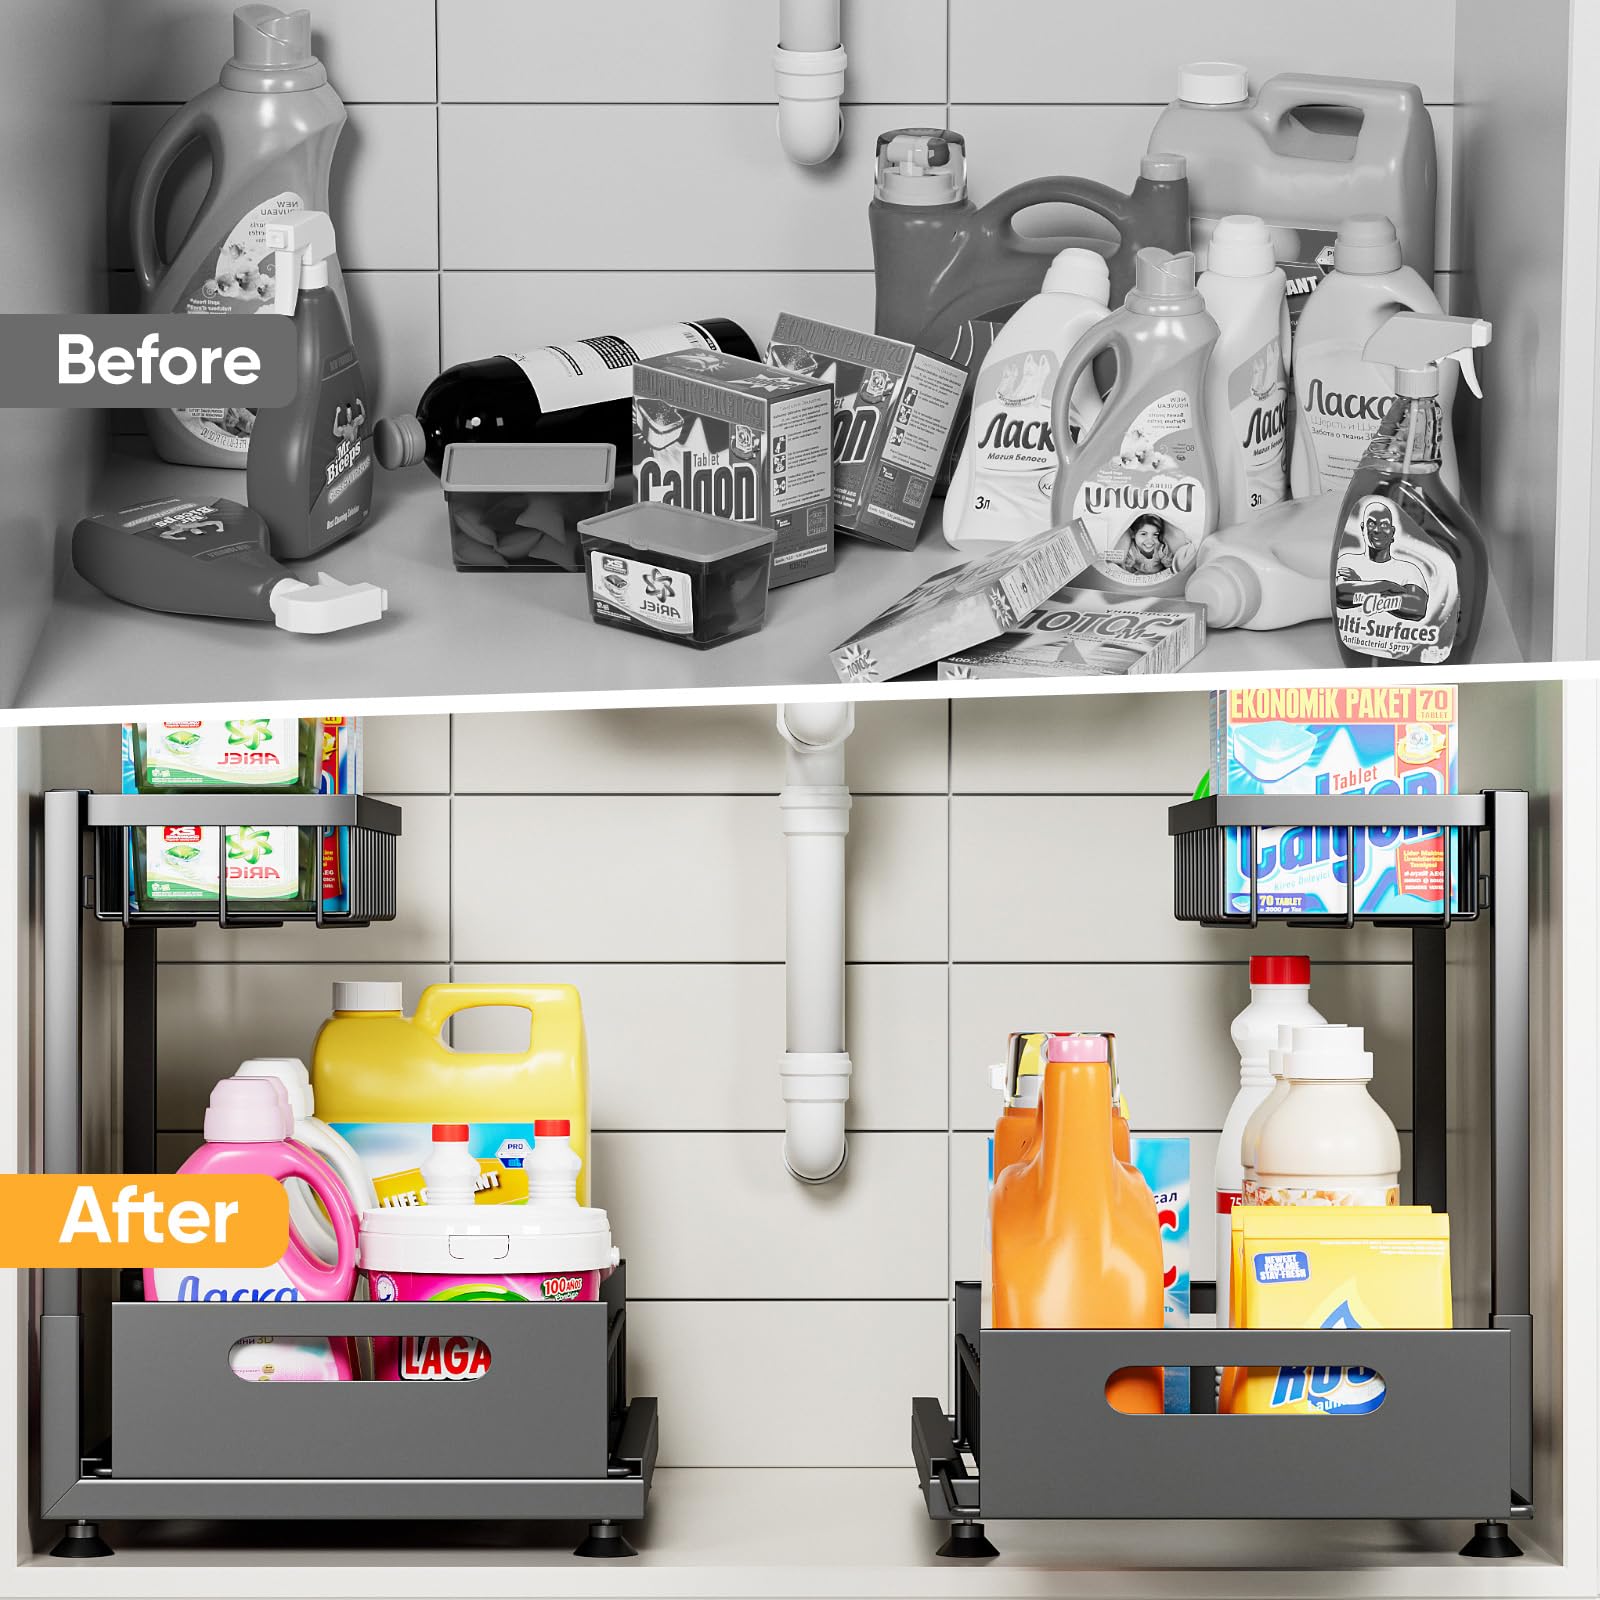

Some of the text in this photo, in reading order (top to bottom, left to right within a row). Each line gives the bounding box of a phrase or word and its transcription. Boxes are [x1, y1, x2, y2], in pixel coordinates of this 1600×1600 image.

[978, 412, 1056, 453] Ласк
[337, 440, 351, 461] Mr
[692, 451, 720, 468] Tablet
[987, 452, 1047, 464] Магия Белого
[326, 440, 361, 485] Biceps
[1363, 594, 1399, 614] Clean
[1388, 642, 1412, 653] Spray
[1345, 687, 1412, 719] PAKET
[1419, 690, 1449, 710] 70
[1332, 765, 1379, 791] Tablet
[1259, 895, 1303, 906] 70 TABLET
[1264, 1254, 1297, 1264] NEWEST
[544, 1278, 566, 1296] 100
